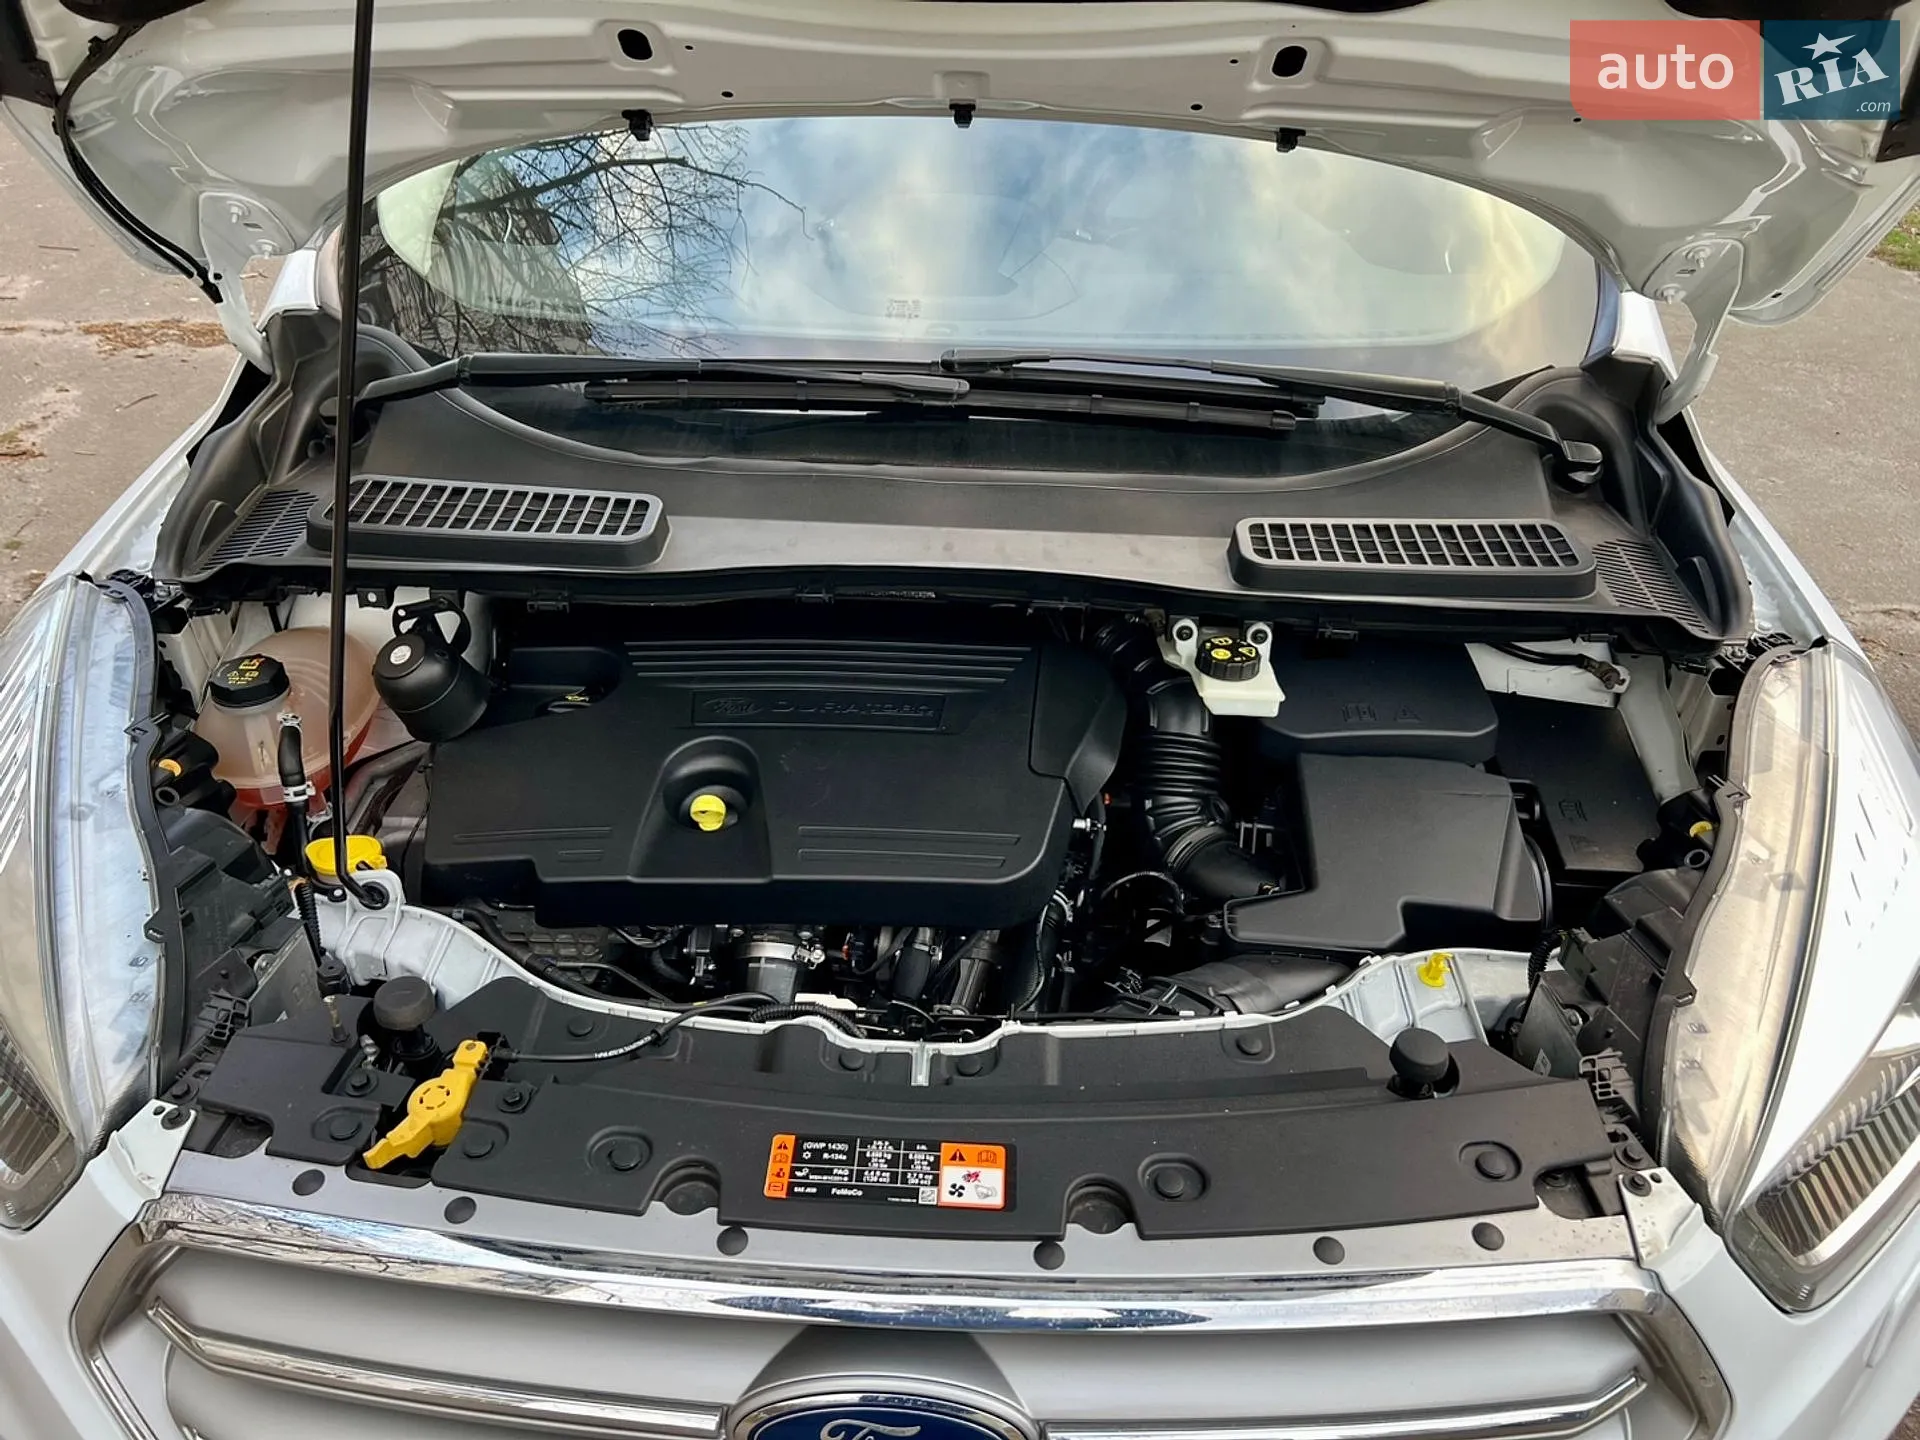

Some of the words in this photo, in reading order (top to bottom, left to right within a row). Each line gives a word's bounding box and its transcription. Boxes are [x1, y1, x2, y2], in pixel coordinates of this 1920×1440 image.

[803, 1141, 826, 1151] (GWP
[828, 1142, 849, 1152] 1430)
[822, 1152, 847, 1160] R-134a
